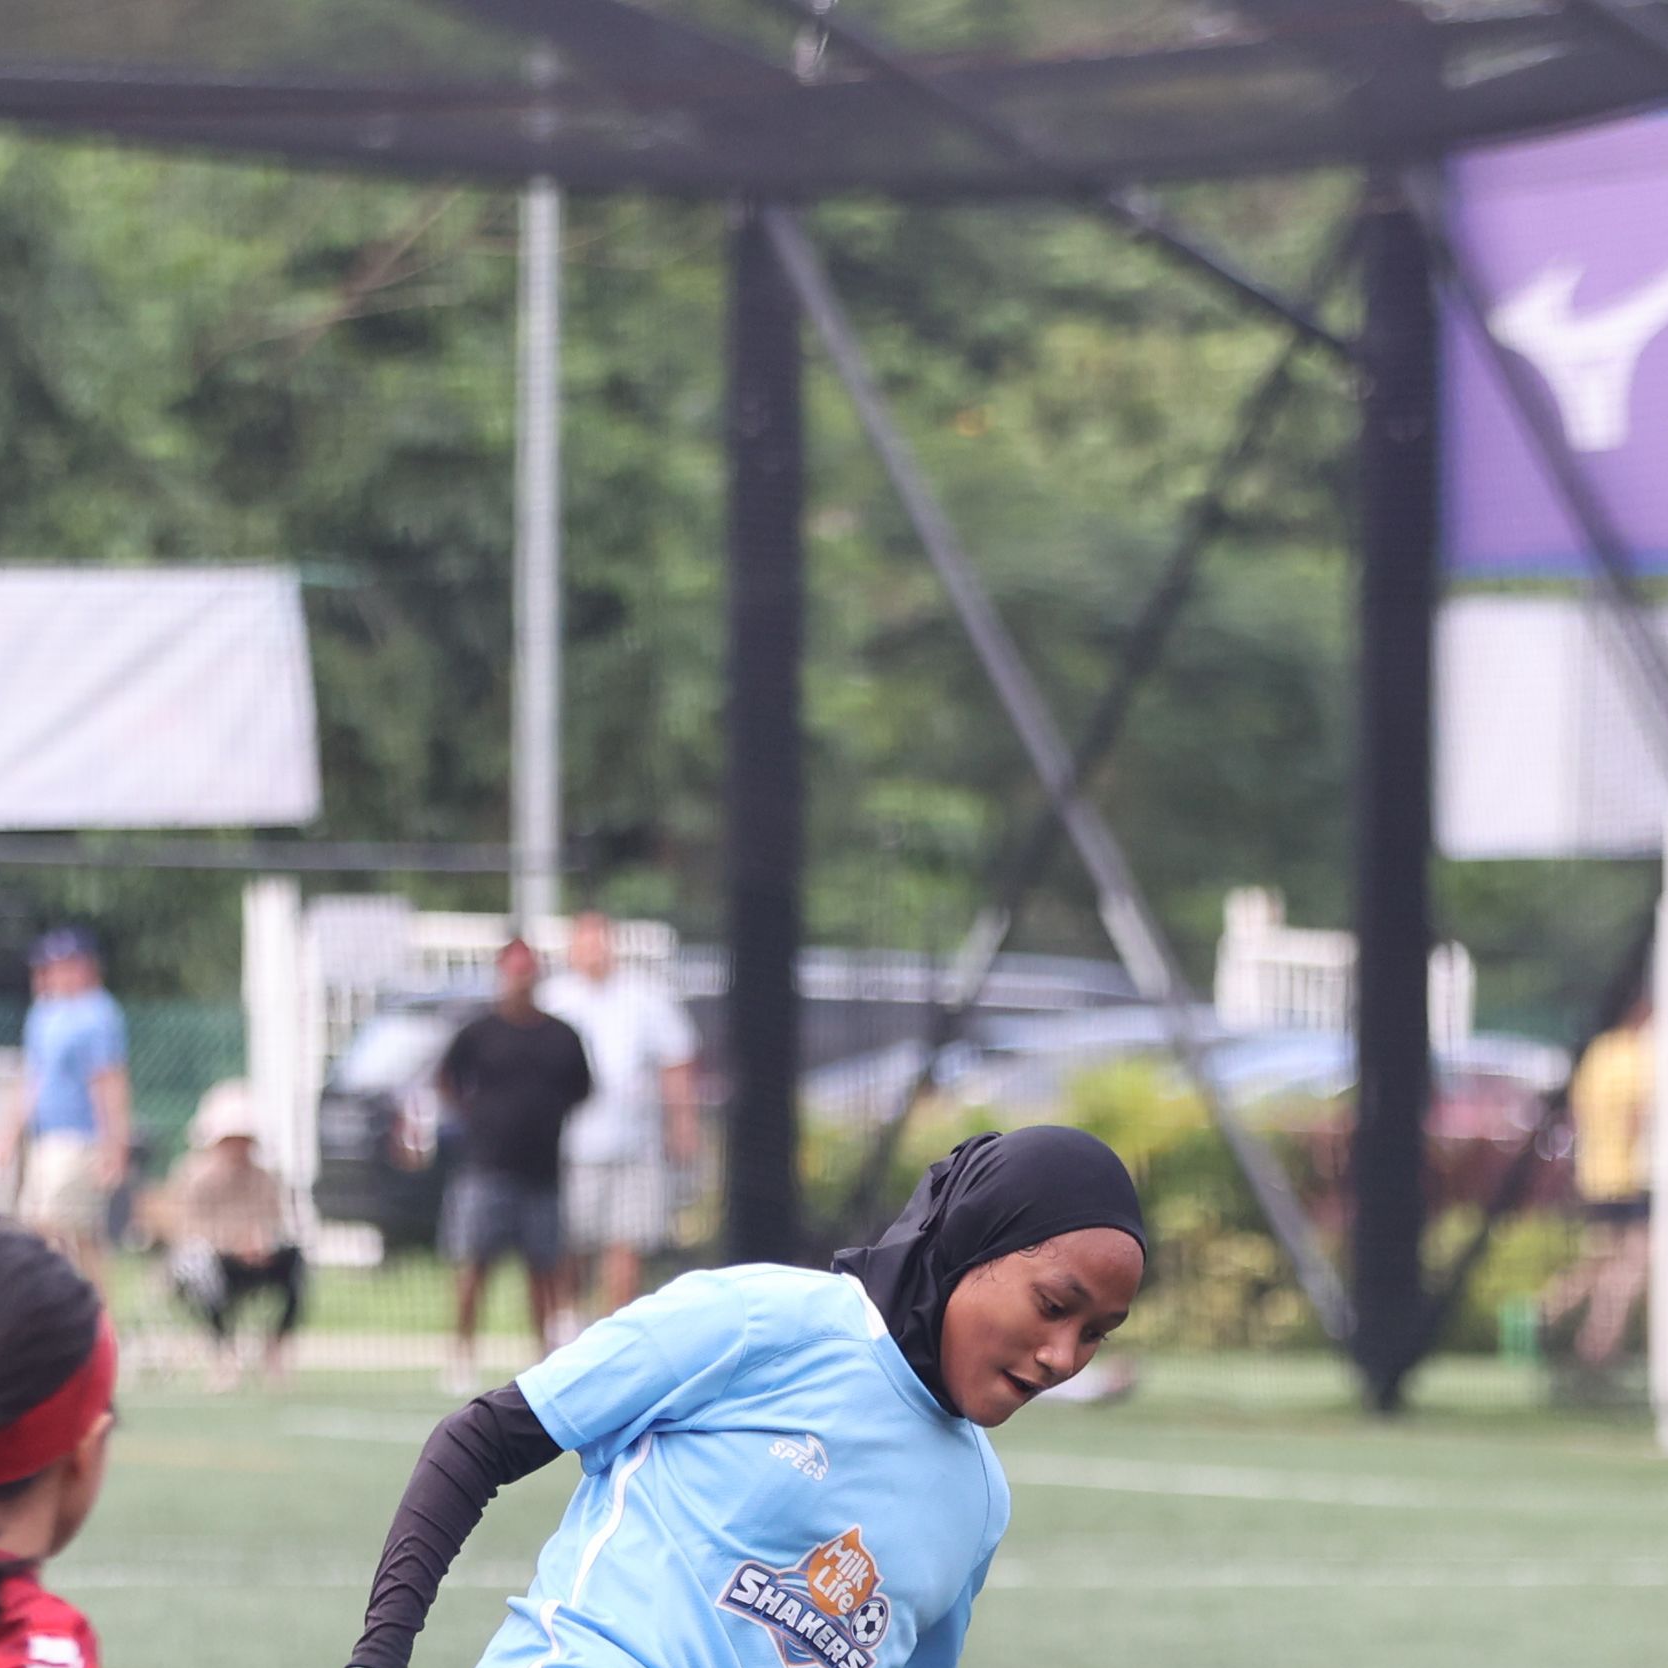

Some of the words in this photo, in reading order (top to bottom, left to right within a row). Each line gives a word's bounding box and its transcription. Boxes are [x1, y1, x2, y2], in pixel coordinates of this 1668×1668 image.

[768, 1440, 828, 1481] SPECS
[812, 1565, 855, 1613] Life
[823, 1539, 870, 1592] Milk
